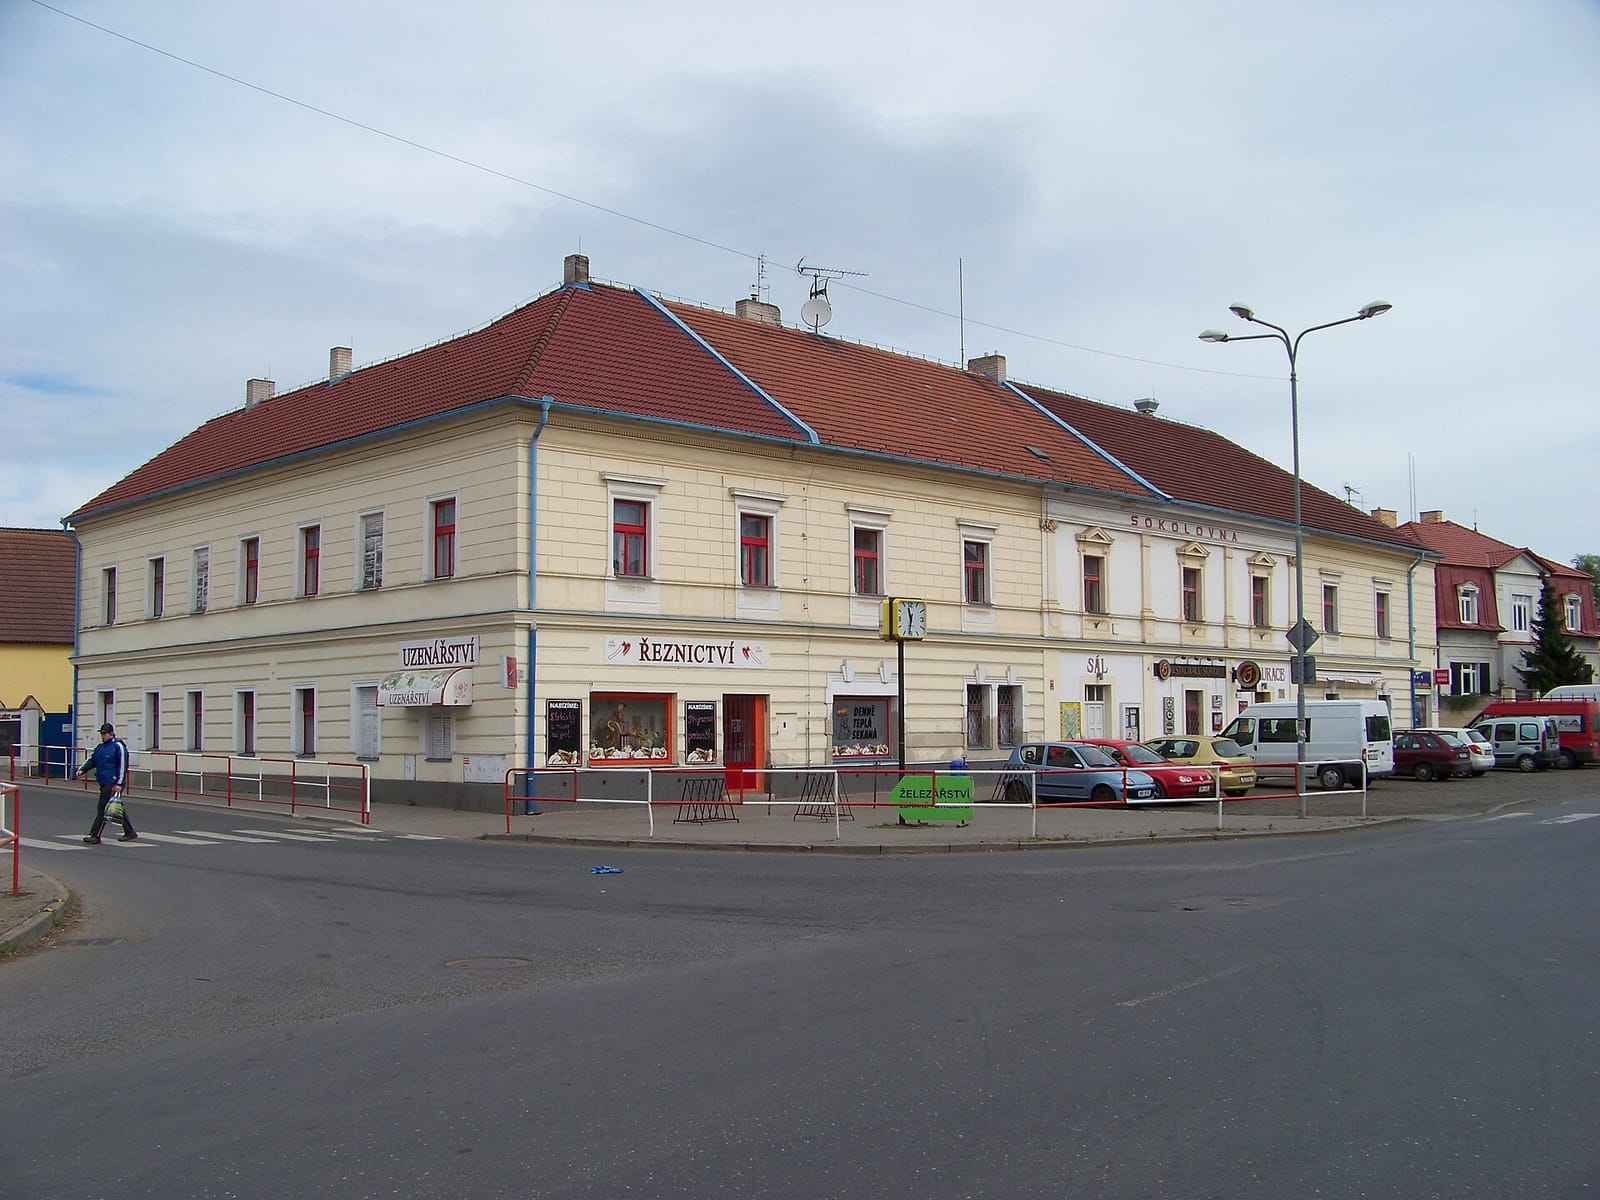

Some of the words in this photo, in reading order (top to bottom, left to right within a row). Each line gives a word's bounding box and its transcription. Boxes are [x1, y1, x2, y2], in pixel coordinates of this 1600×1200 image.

[1130, 515, 1238, 542] SOKOLOVNA
[402, 637, 475, 667] UZENÁŘSTVÍ
[639, 637, 734, 664] ŘEZNICTVÍ
[1087, 655, 1108, 673] SÁL
[1261, 667, 1286, 682] URACE
[389, 690, 430, 705] UZENÁŘSTVÍ
[853, 704, 876, 717] DENNĚ
